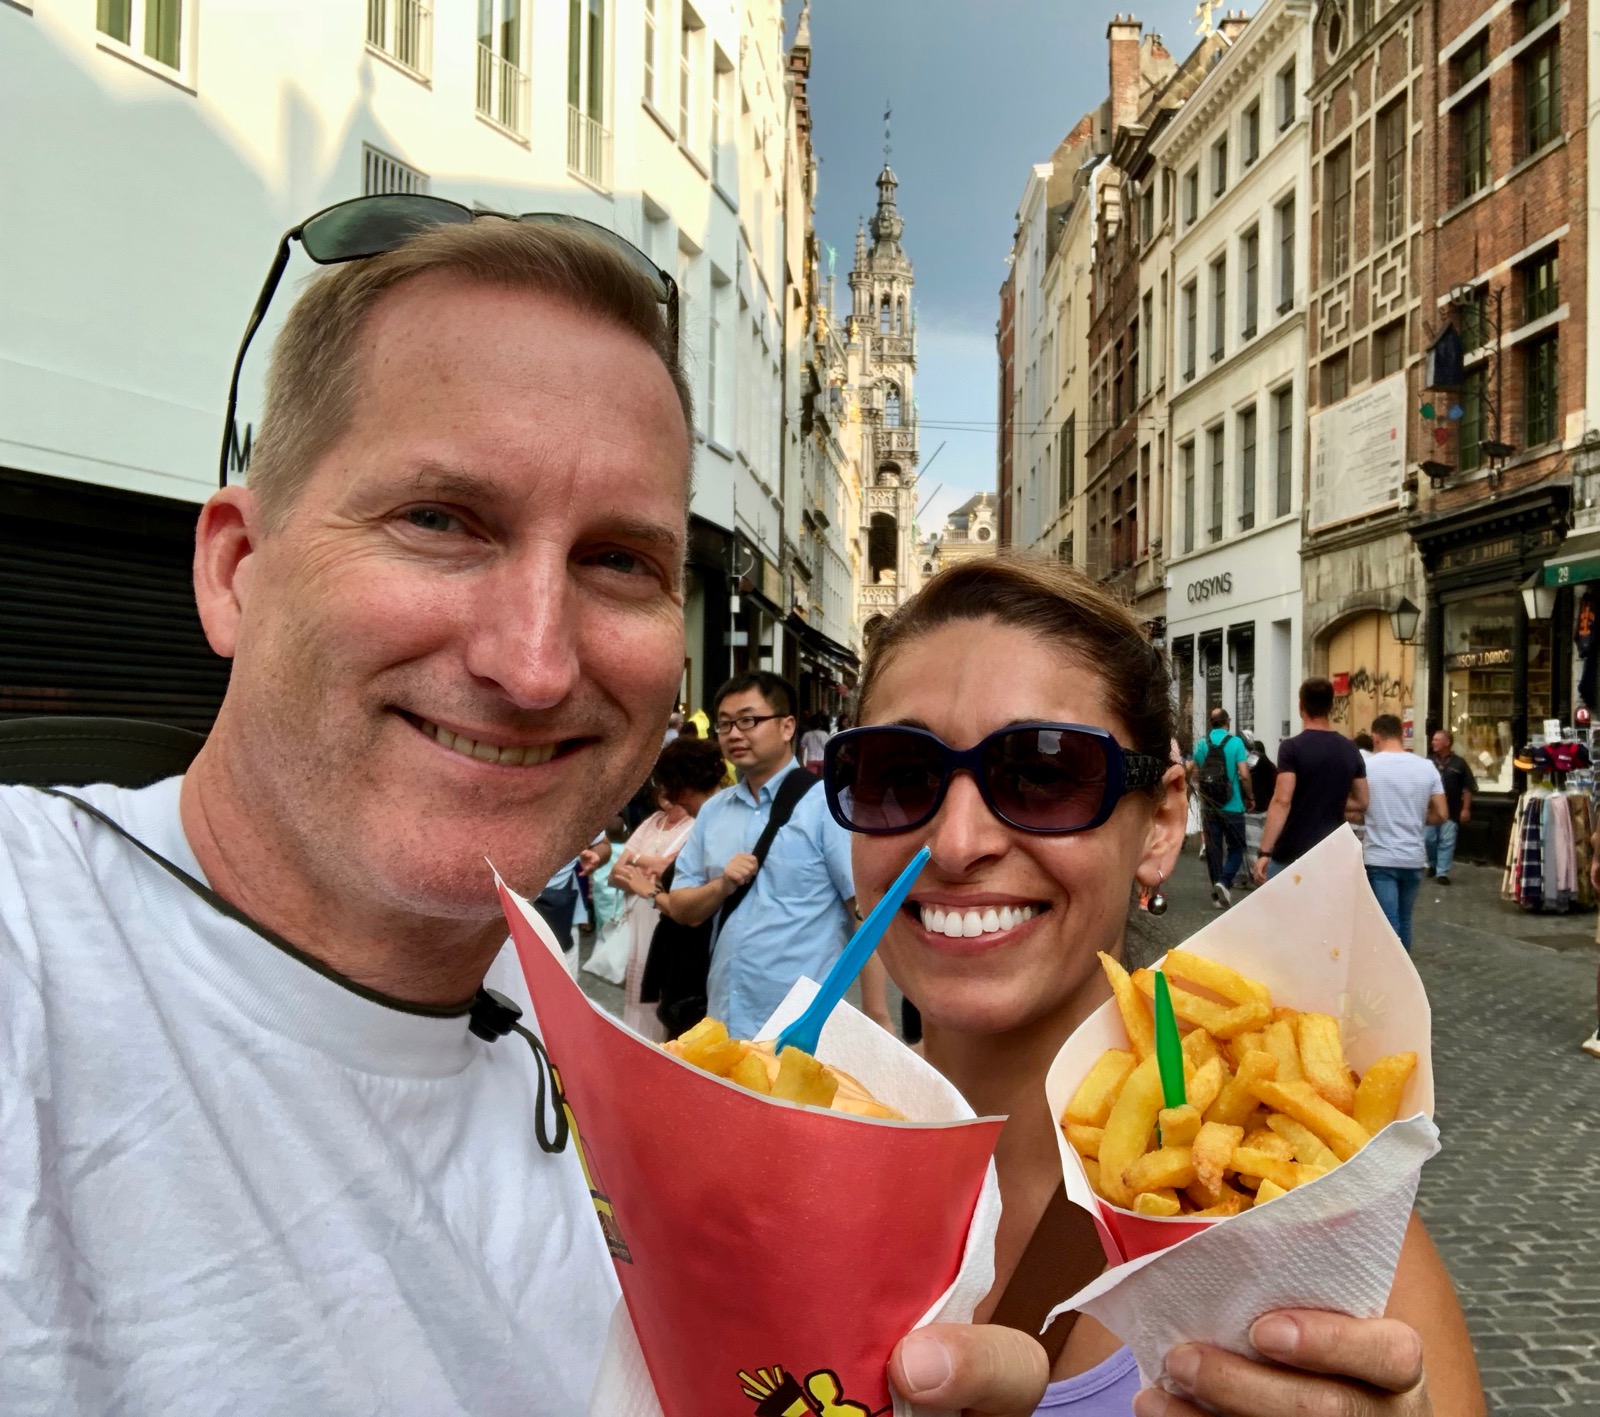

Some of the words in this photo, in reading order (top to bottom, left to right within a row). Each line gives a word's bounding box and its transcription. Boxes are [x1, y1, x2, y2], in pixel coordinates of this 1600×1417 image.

[230, 419, 253, 473] M
[1558, 566, 1569, 583] 29
[1187, 572, 1232, 603] COSYNS
[1208, 665, 1221, 677] COS
